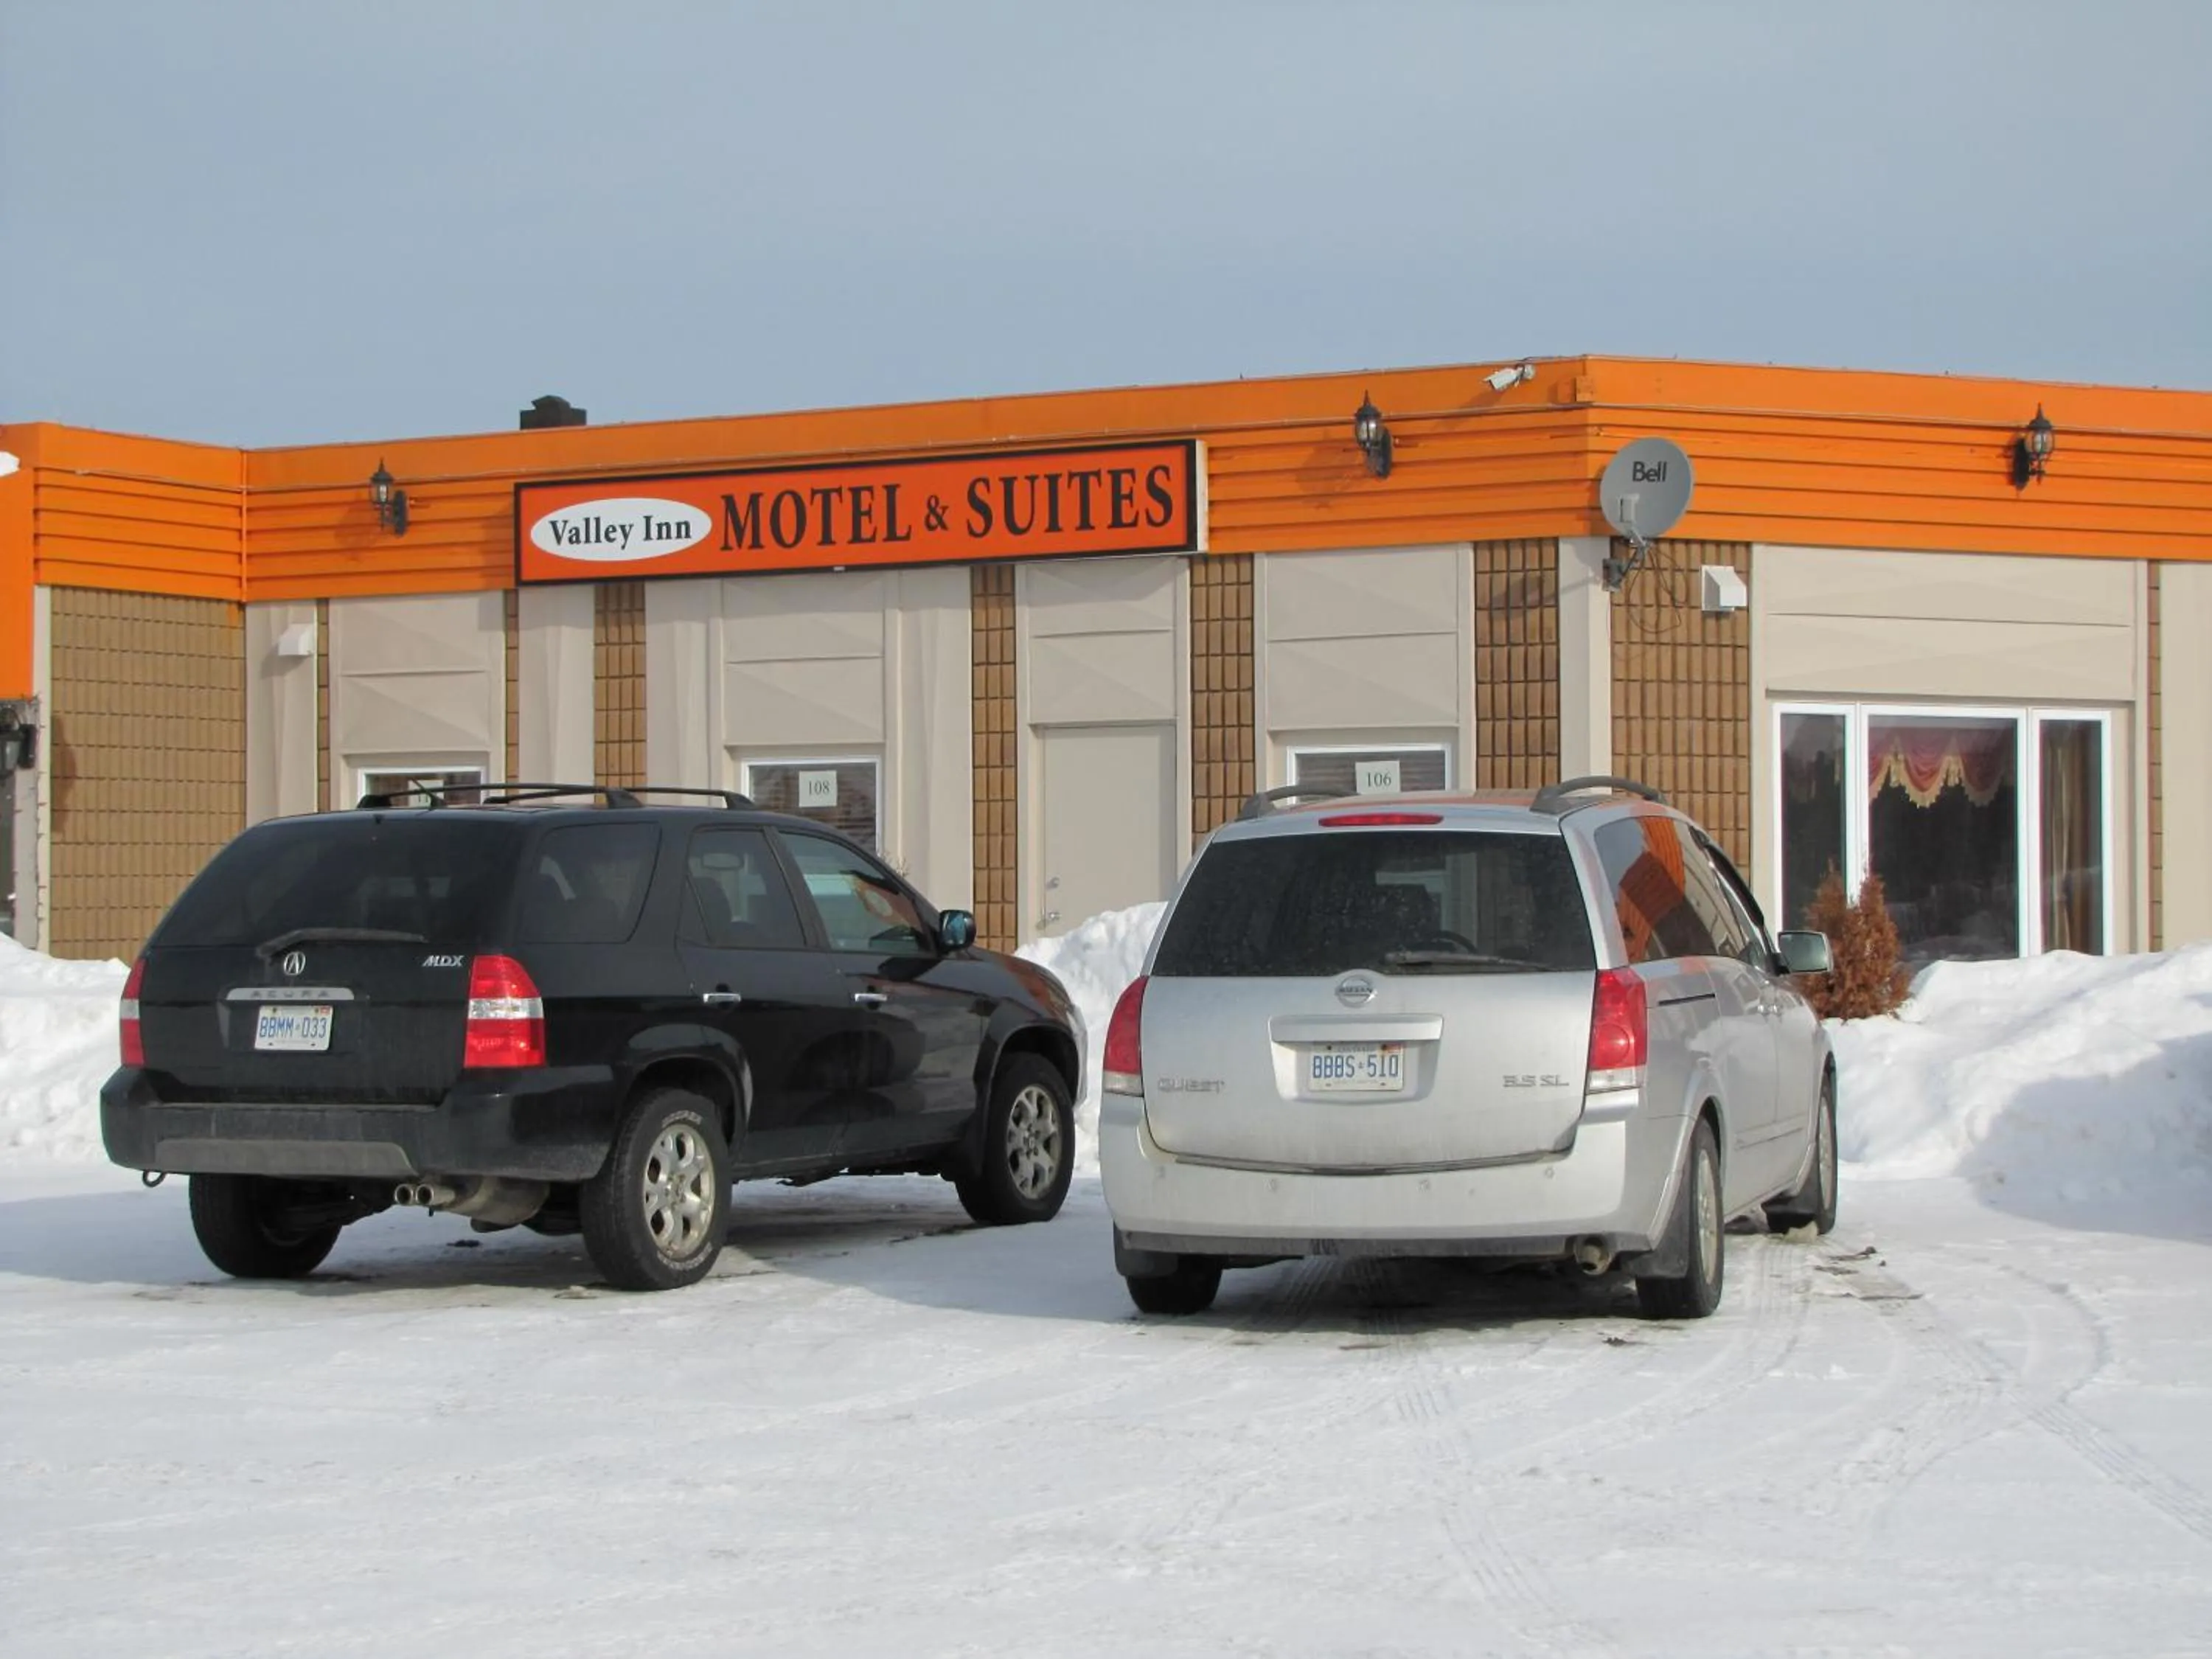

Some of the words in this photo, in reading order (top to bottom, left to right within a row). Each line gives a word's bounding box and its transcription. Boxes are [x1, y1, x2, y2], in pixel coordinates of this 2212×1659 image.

[1632, 460, 1668, 482] Bell
[720, 483, 912, 551] MOTEL
[923, 494, 950, 532] &
[966, 464, 1173, 538] SUITES
[549, 515, 635, 550] Valley
[642, 515, 692, 542] Inn
[808, 779, 830, 796] 108
[1366, 771, 1392, 787] 106
